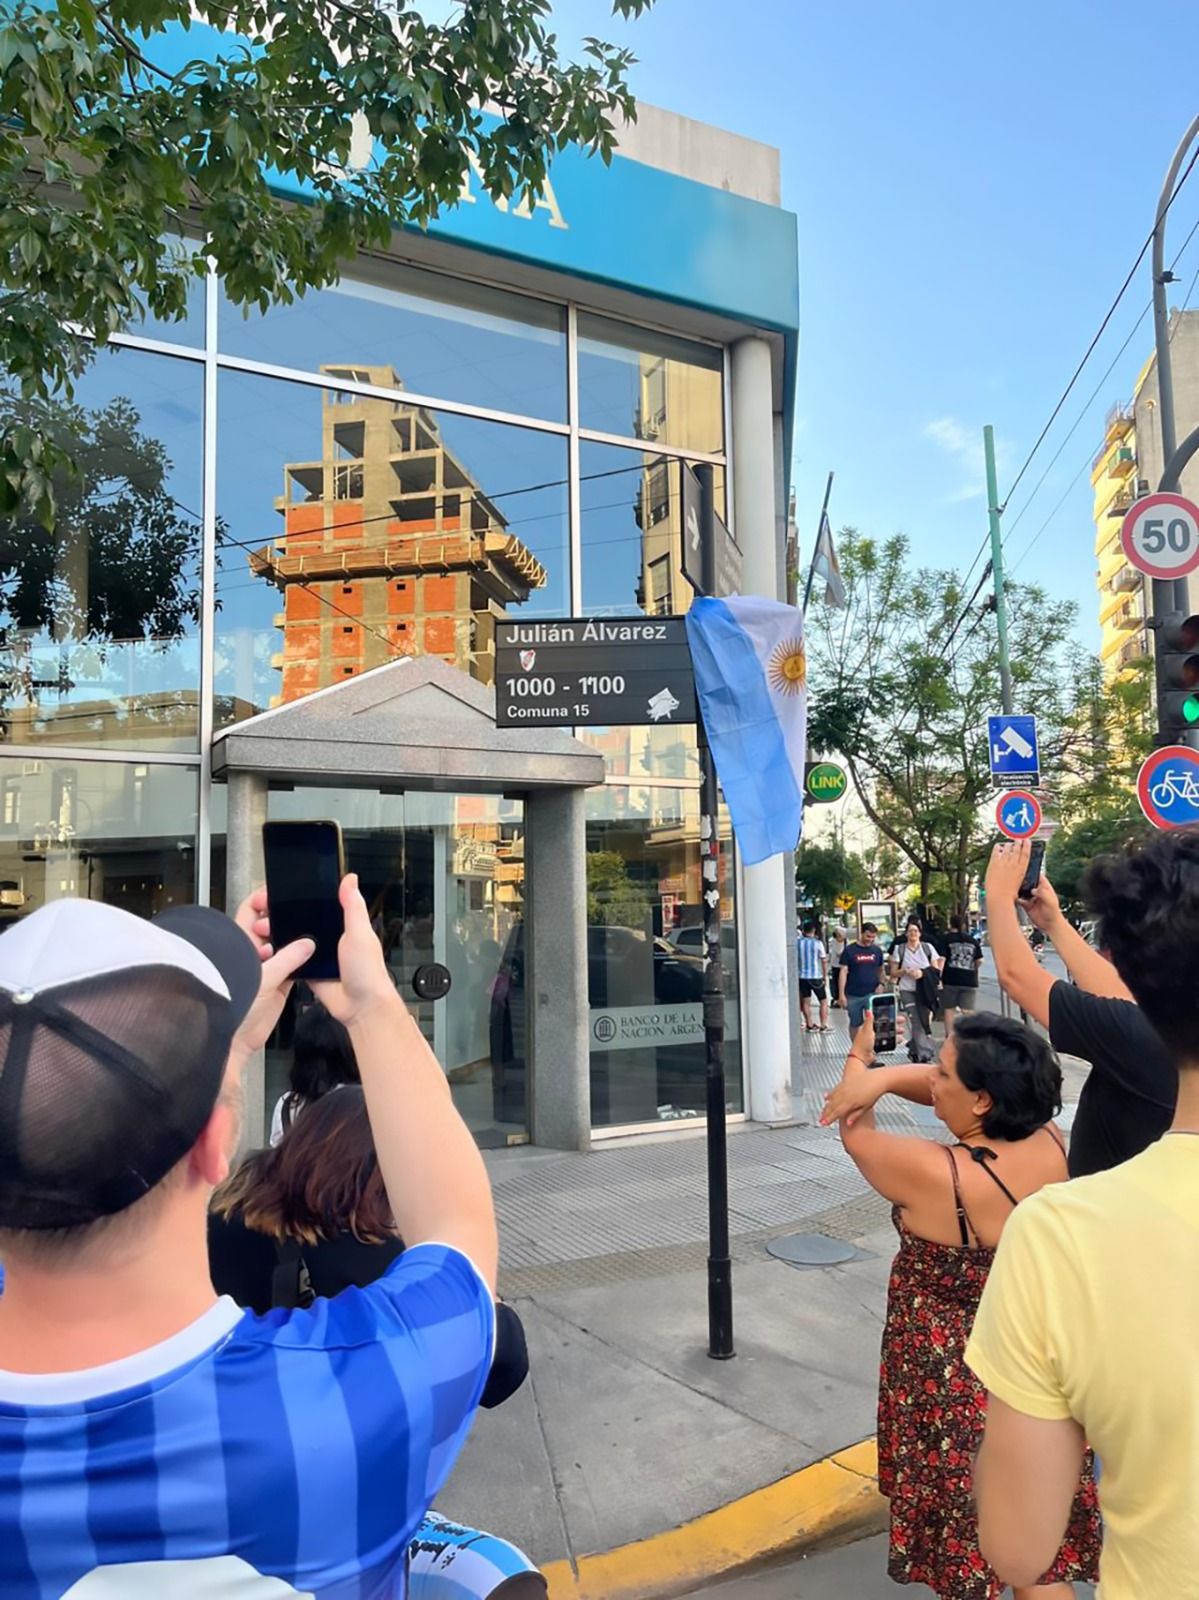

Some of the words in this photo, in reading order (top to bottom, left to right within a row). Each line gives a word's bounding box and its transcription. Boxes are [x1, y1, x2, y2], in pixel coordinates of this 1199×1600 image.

[1142, 518, 1190, 553] 50
[506, 625, 574, 643] Julián
[582, 619, 666, 641] Álvarez
[506, 678, 555, 696] 1000
[507, 705, 568, 718] Comuna
[573, 704, 589, 716] 15
[811, 773, 842, 789] LINK
[621, 1015, 660, 1027] BANCO
[664, 1013, 679, 1024] DE
[682, 1012, 696, 1023] LA
